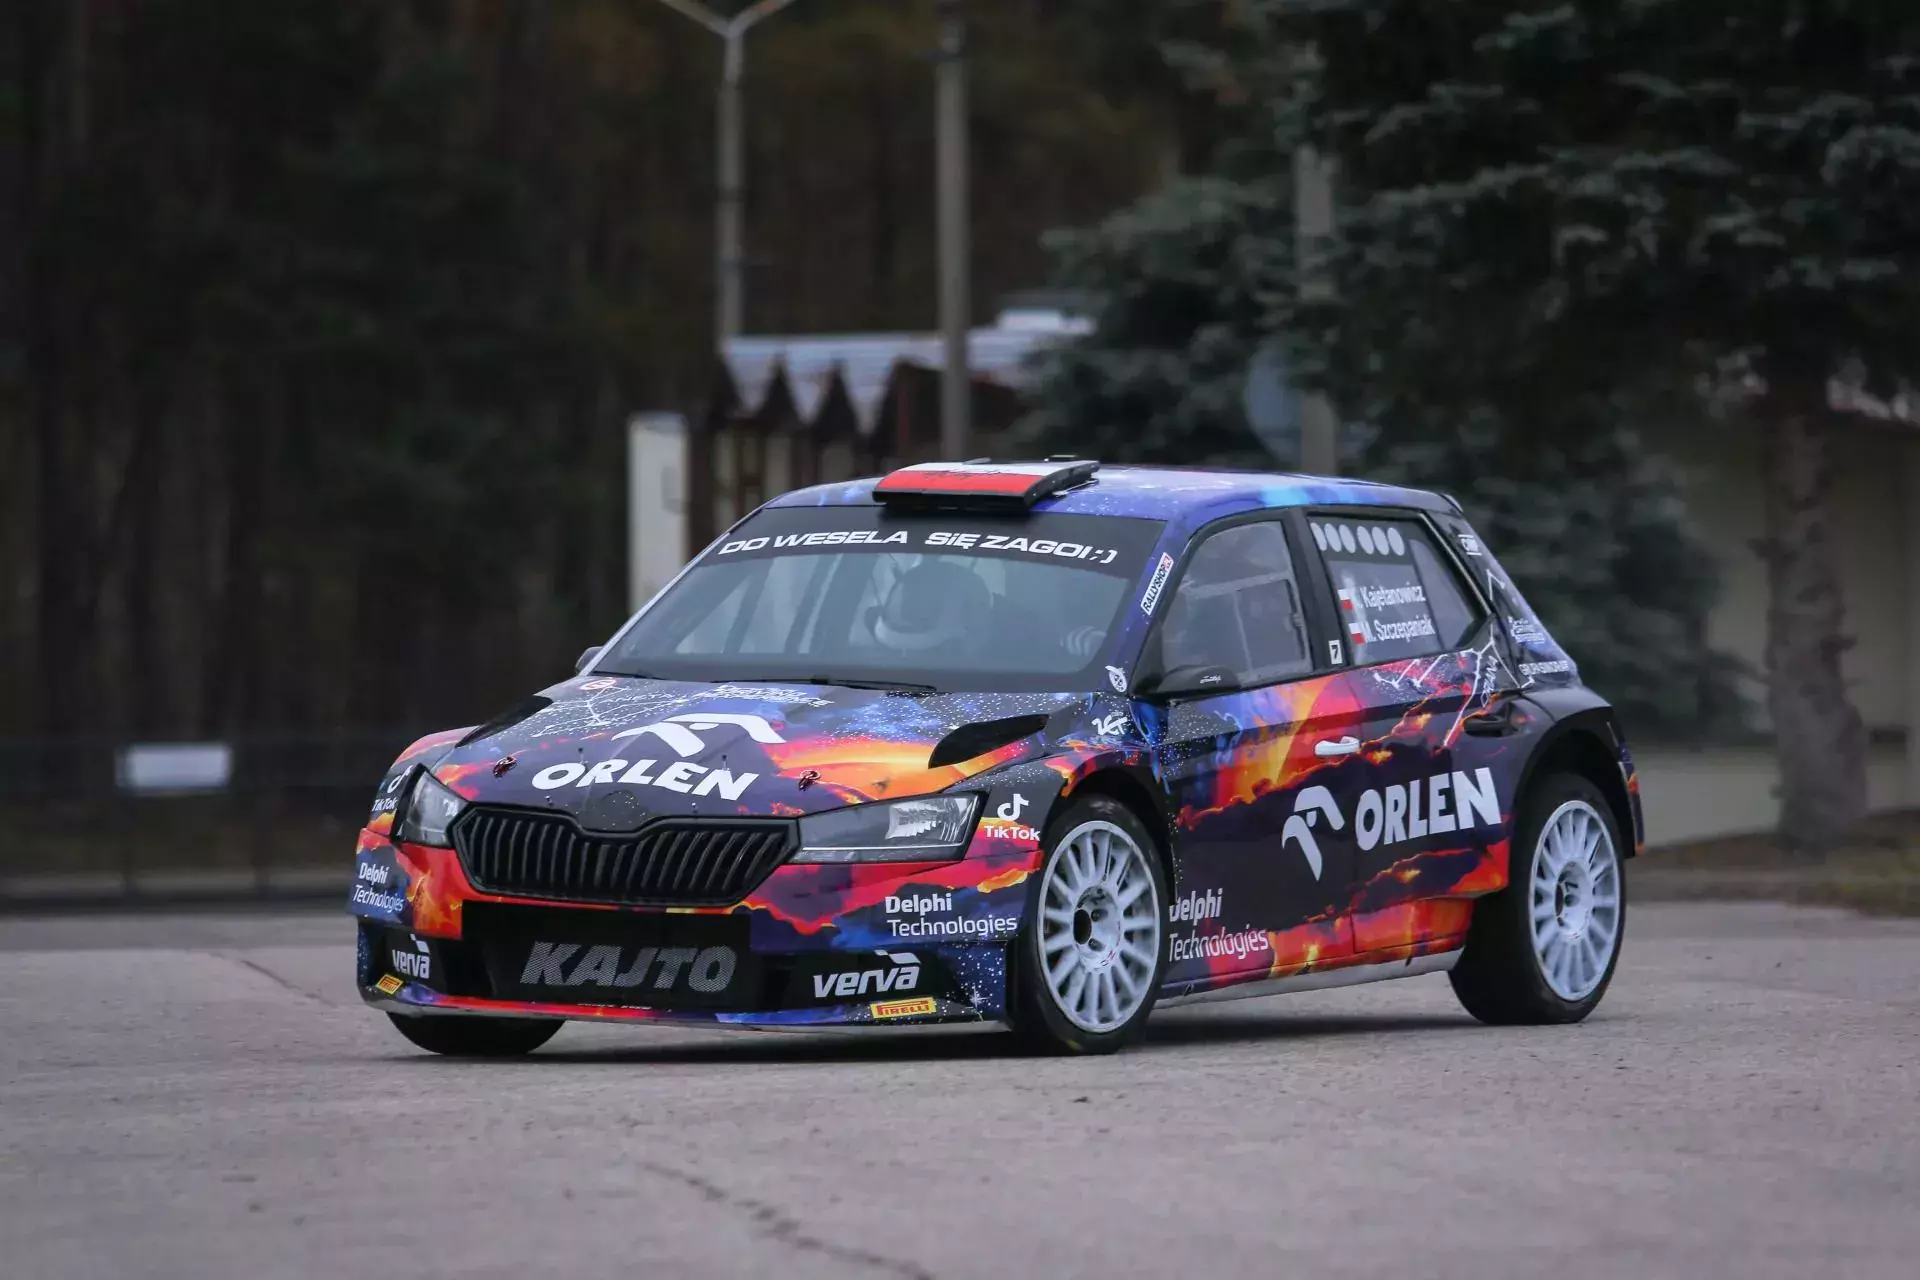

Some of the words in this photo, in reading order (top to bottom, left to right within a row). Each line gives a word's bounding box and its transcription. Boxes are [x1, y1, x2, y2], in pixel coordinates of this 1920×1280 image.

[718, 537, 770, 554] DO
[773, 531, 908, 547] WESELA
[532, 758, 760, 801] ORLEN
[1355, 767, 1502, 851] ORLEN
[984, 825, 1041, 842] TikTok
[359, 862, 389, 884] Delphi
[353, 885, 404, 913] Technologies
[885, 893, 952, 916] Delphi
[887, 914, 1018, 937] Technologies
[1169, 923, 1270, 963] Technologies
[392, 949, 430, 979] verva
[520, 941, 738, 993] KAJTO
[813, 966, 920, 998] verva
